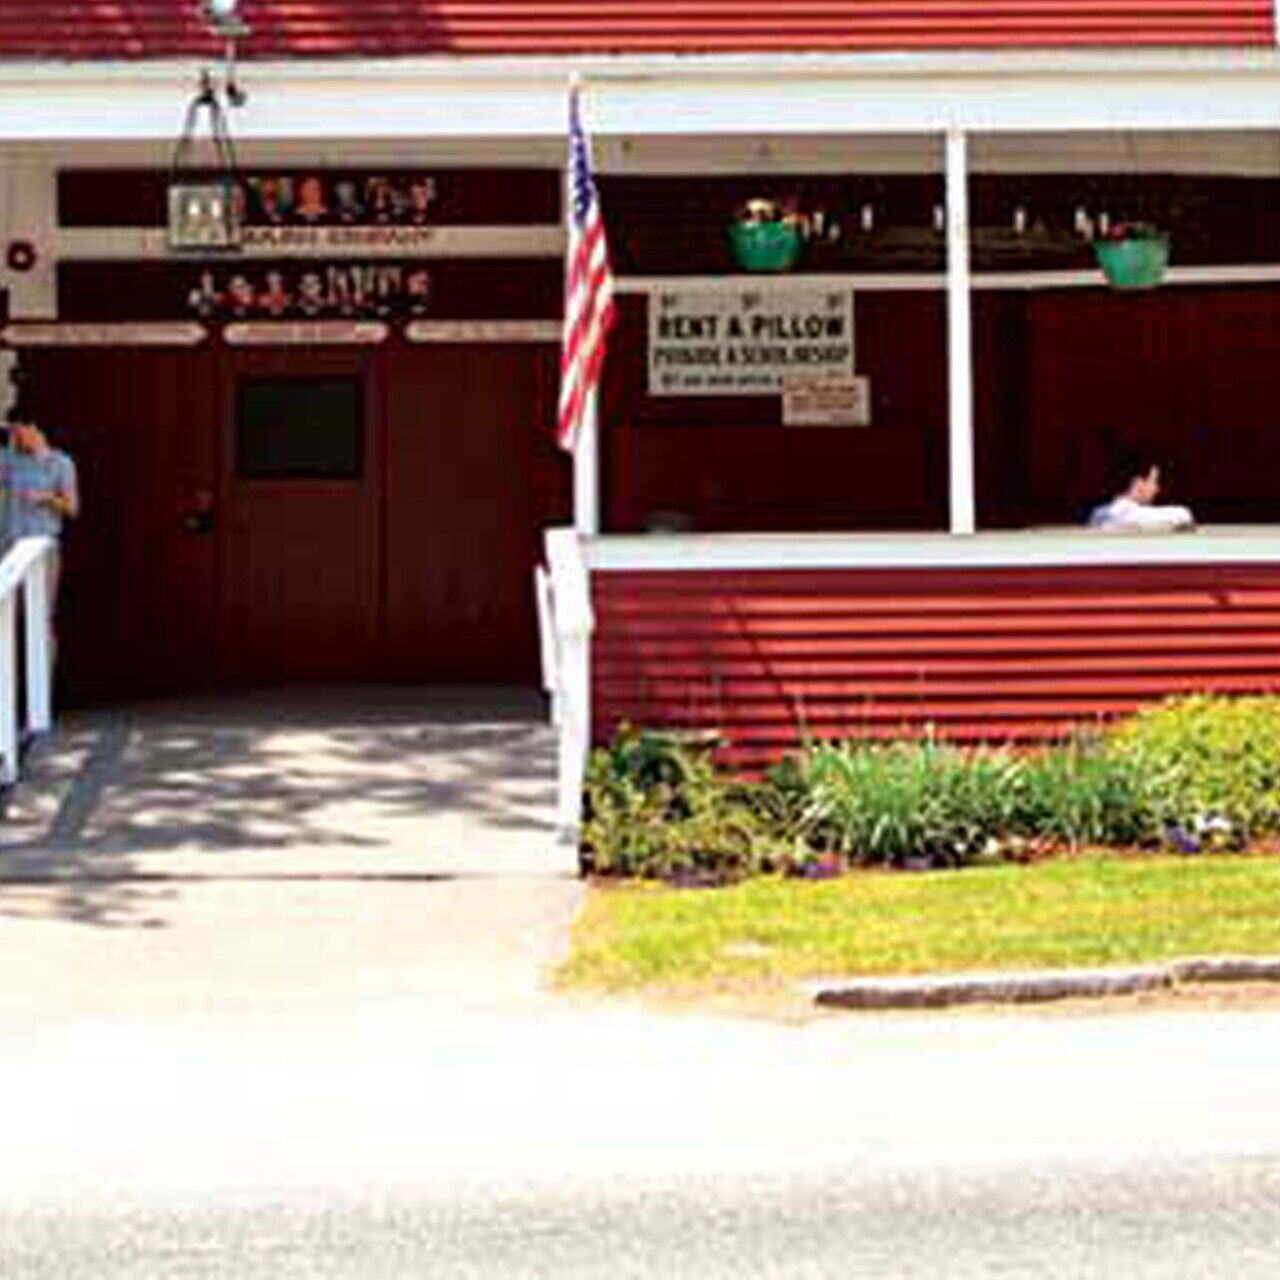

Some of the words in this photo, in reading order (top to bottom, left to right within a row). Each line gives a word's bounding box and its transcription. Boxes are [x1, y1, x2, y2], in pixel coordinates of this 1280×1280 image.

[658, 314, 717, 339] RENT
[727, 314, 743, 339] A
[751, 314, 845, 339] PILLOW
